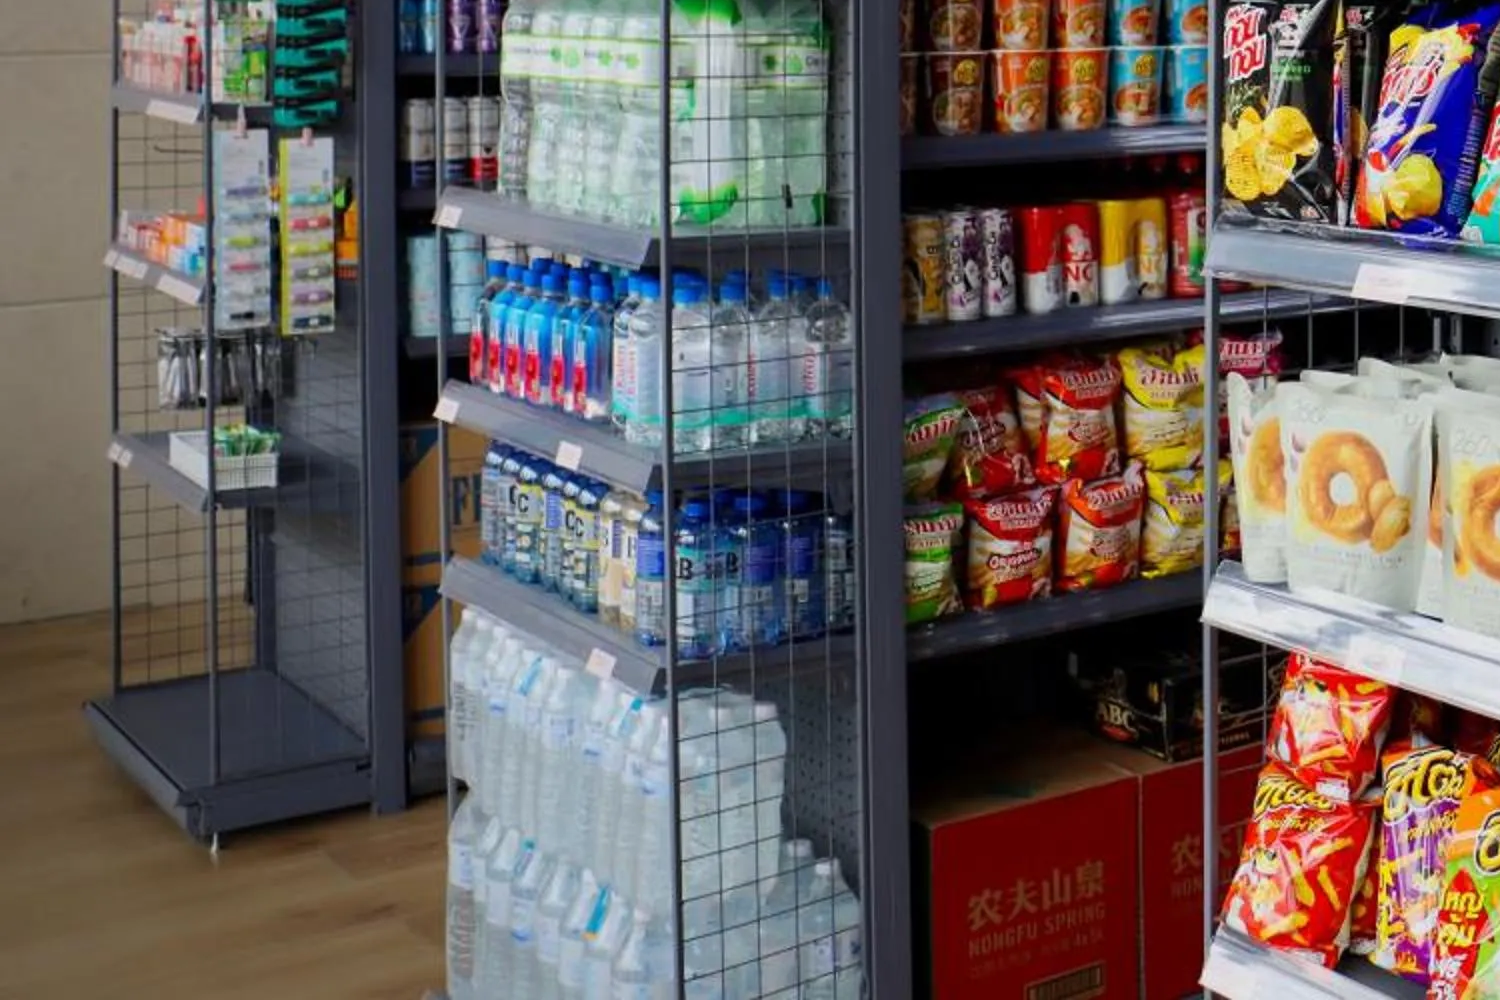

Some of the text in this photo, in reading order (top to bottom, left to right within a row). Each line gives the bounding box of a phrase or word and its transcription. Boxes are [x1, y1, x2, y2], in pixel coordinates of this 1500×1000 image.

[1098, 702, 1136, 731] ABC
[967, 859, 1105, 931] 农夫山泉
[968, 919, 1039, 958] NONGFU
[1043, 901, 1106, 936] SPRING
